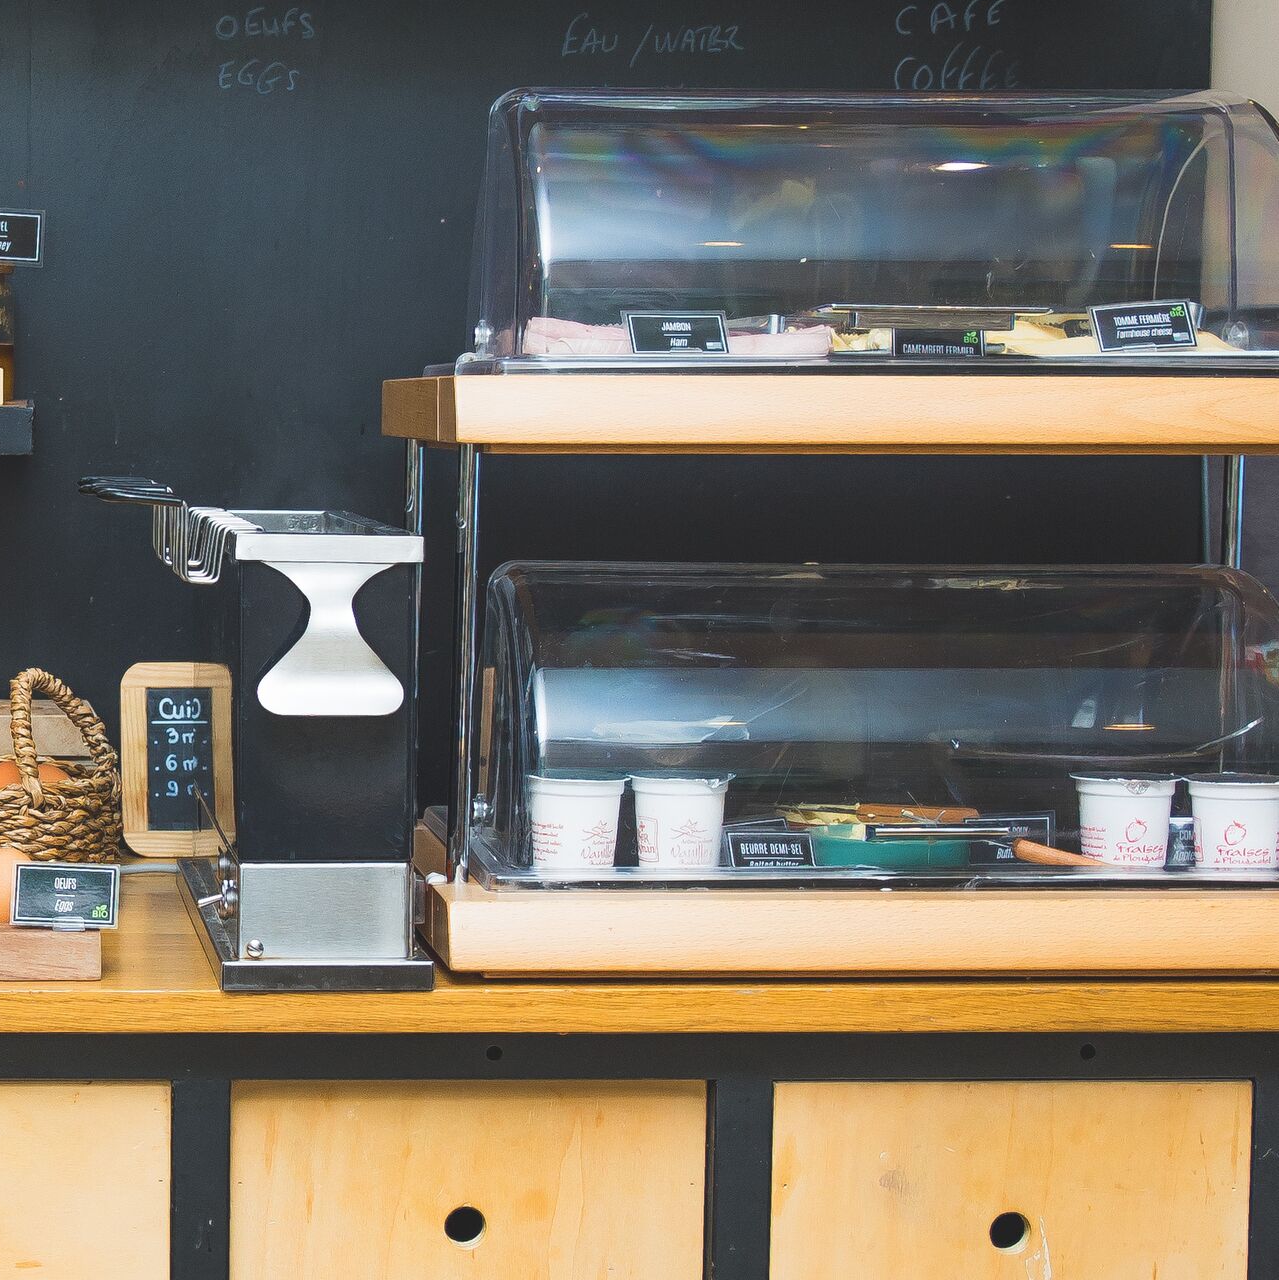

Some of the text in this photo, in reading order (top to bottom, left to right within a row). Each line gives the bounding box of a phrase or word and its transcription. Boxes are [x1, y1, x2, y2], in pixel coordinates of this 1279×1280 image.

[216, 7, 314, 40] OEUFS
[219, 59, 300, 94] EGGS
[1113, 312, 1171, 327] TOMME FERMIÈRE
[661, 322, 691, 331] JAMBON
[1116, 328, 1173, 339] Farmhouse cheese
[670, 338, 687, 347] Ham
[903, 343, 974, 355] CAMEMBERT FERMIER
[166, 727, 179, 744] 3
[166, 754, 178, 771] 6
[740, 843, 804, 855] BEURRE DEMI-SEL
[1116, 842, 1163, 854] Fraises
[1216, 845, 1269, 857] Fraises
[54, 877, 77, 890] OEUFS
[54, 899, 74, 912] Eggs
[92, 909, 108, 918] BIO
